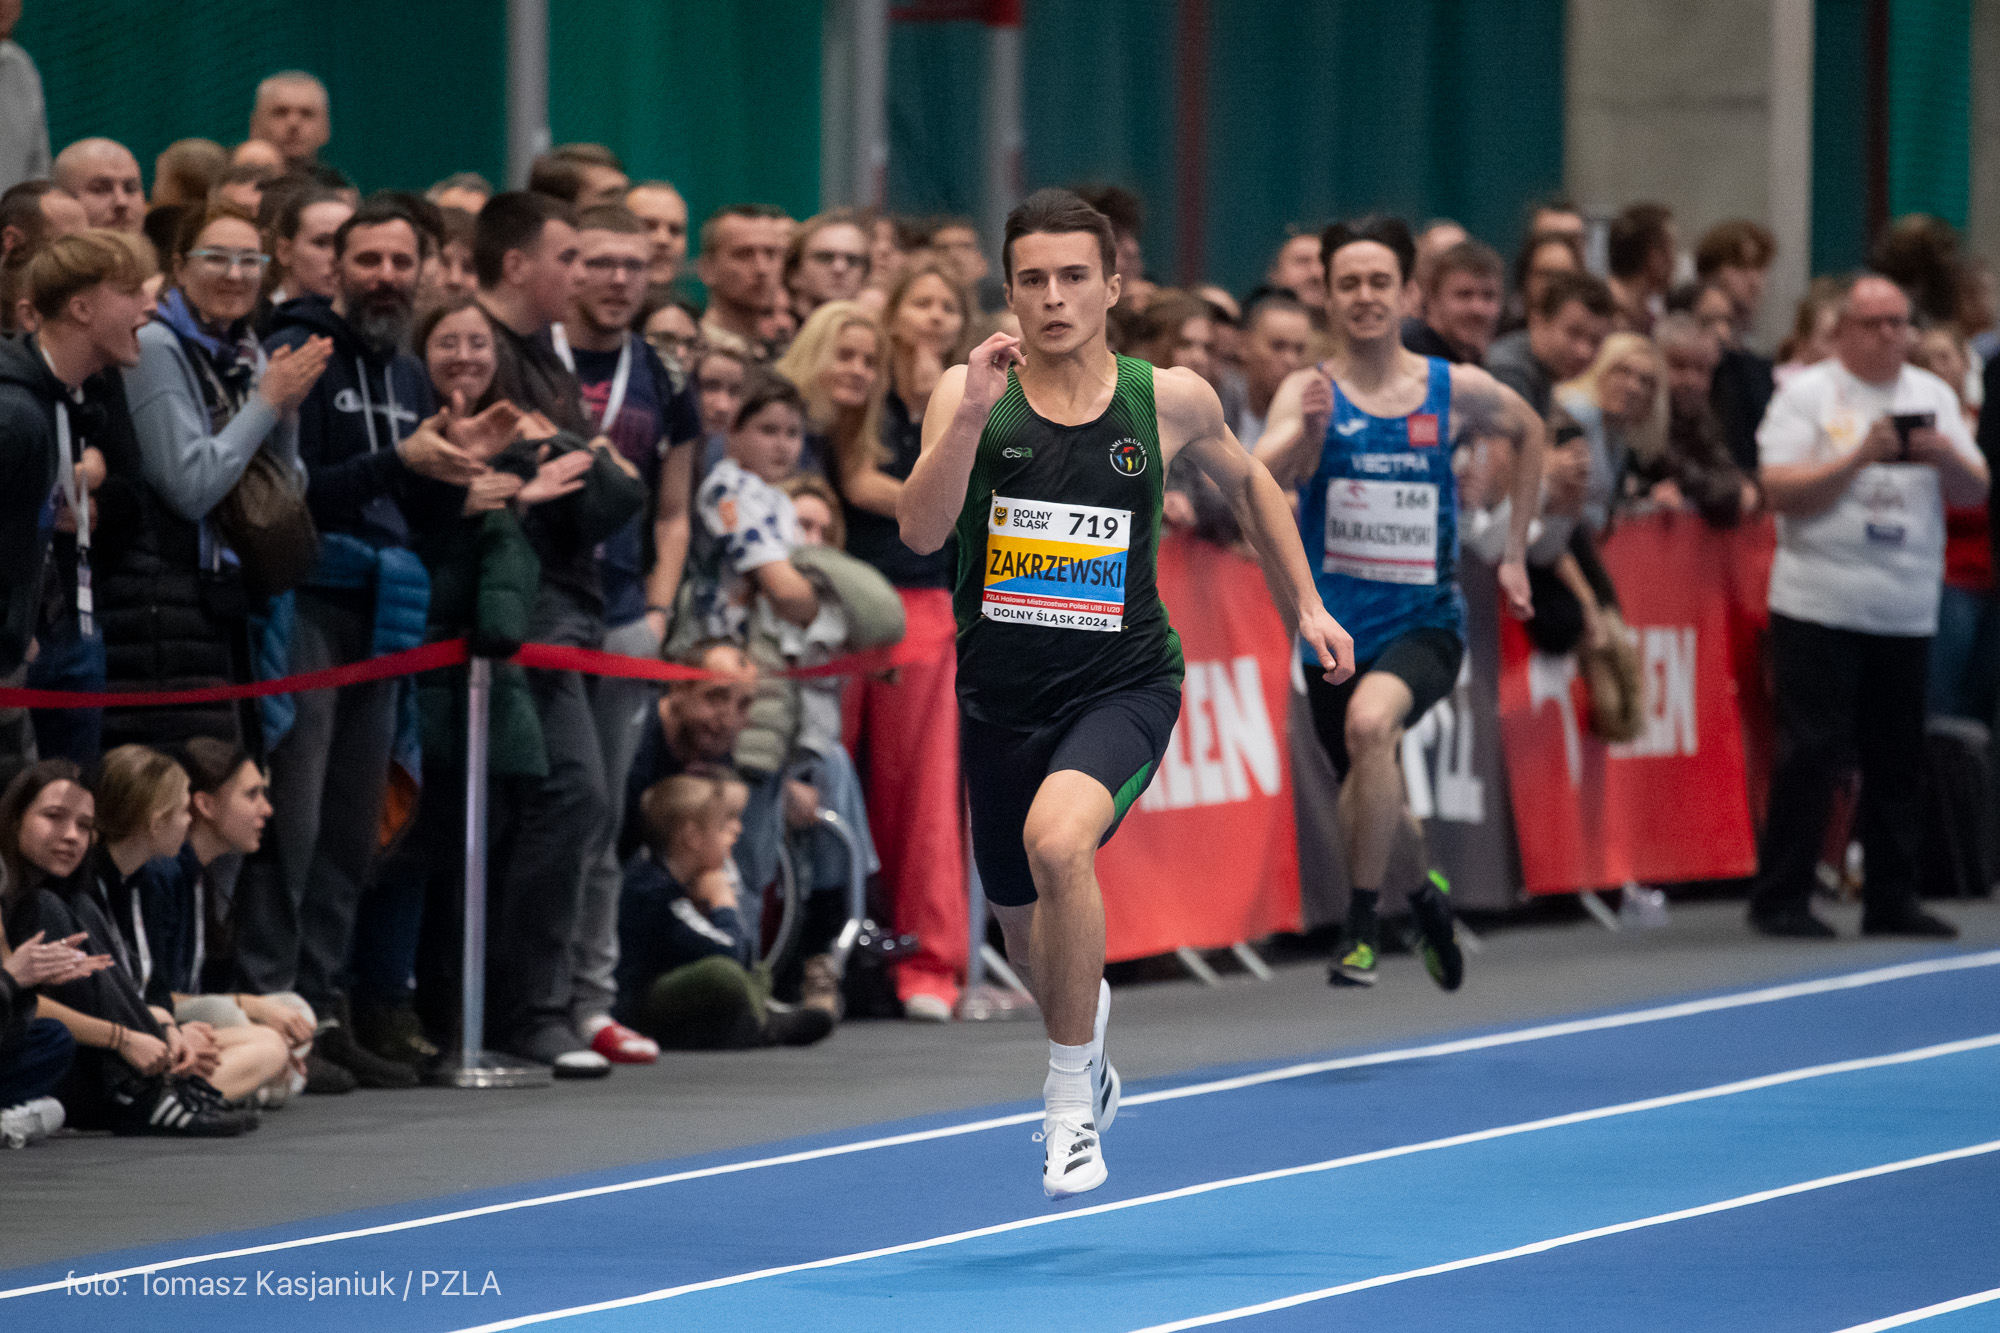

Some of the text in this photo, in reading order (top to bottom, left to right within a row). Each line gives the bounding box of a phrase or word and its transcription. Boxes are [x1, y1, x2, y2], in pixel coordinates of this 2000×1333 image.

[1013, 508, 1053, 521] DOLNY
[1013, 516, 1048, 531] ŚLĄSK
[1068, 512, 1119, 540] 719
[990, 549, 1122, 588] ZAKRZEWSKI
[986, 593, 1000, 601] PZLA
[1000, 595, 1026, 605] Halowe
[1027, 598, 1068, 609] Mistrzostwa
[1068, 602, 1089, 611] Polski
[1106, 606, 1121, 614] U20
[993, 607, 1108, 628] DOLNY ŚLĄSK 2024
